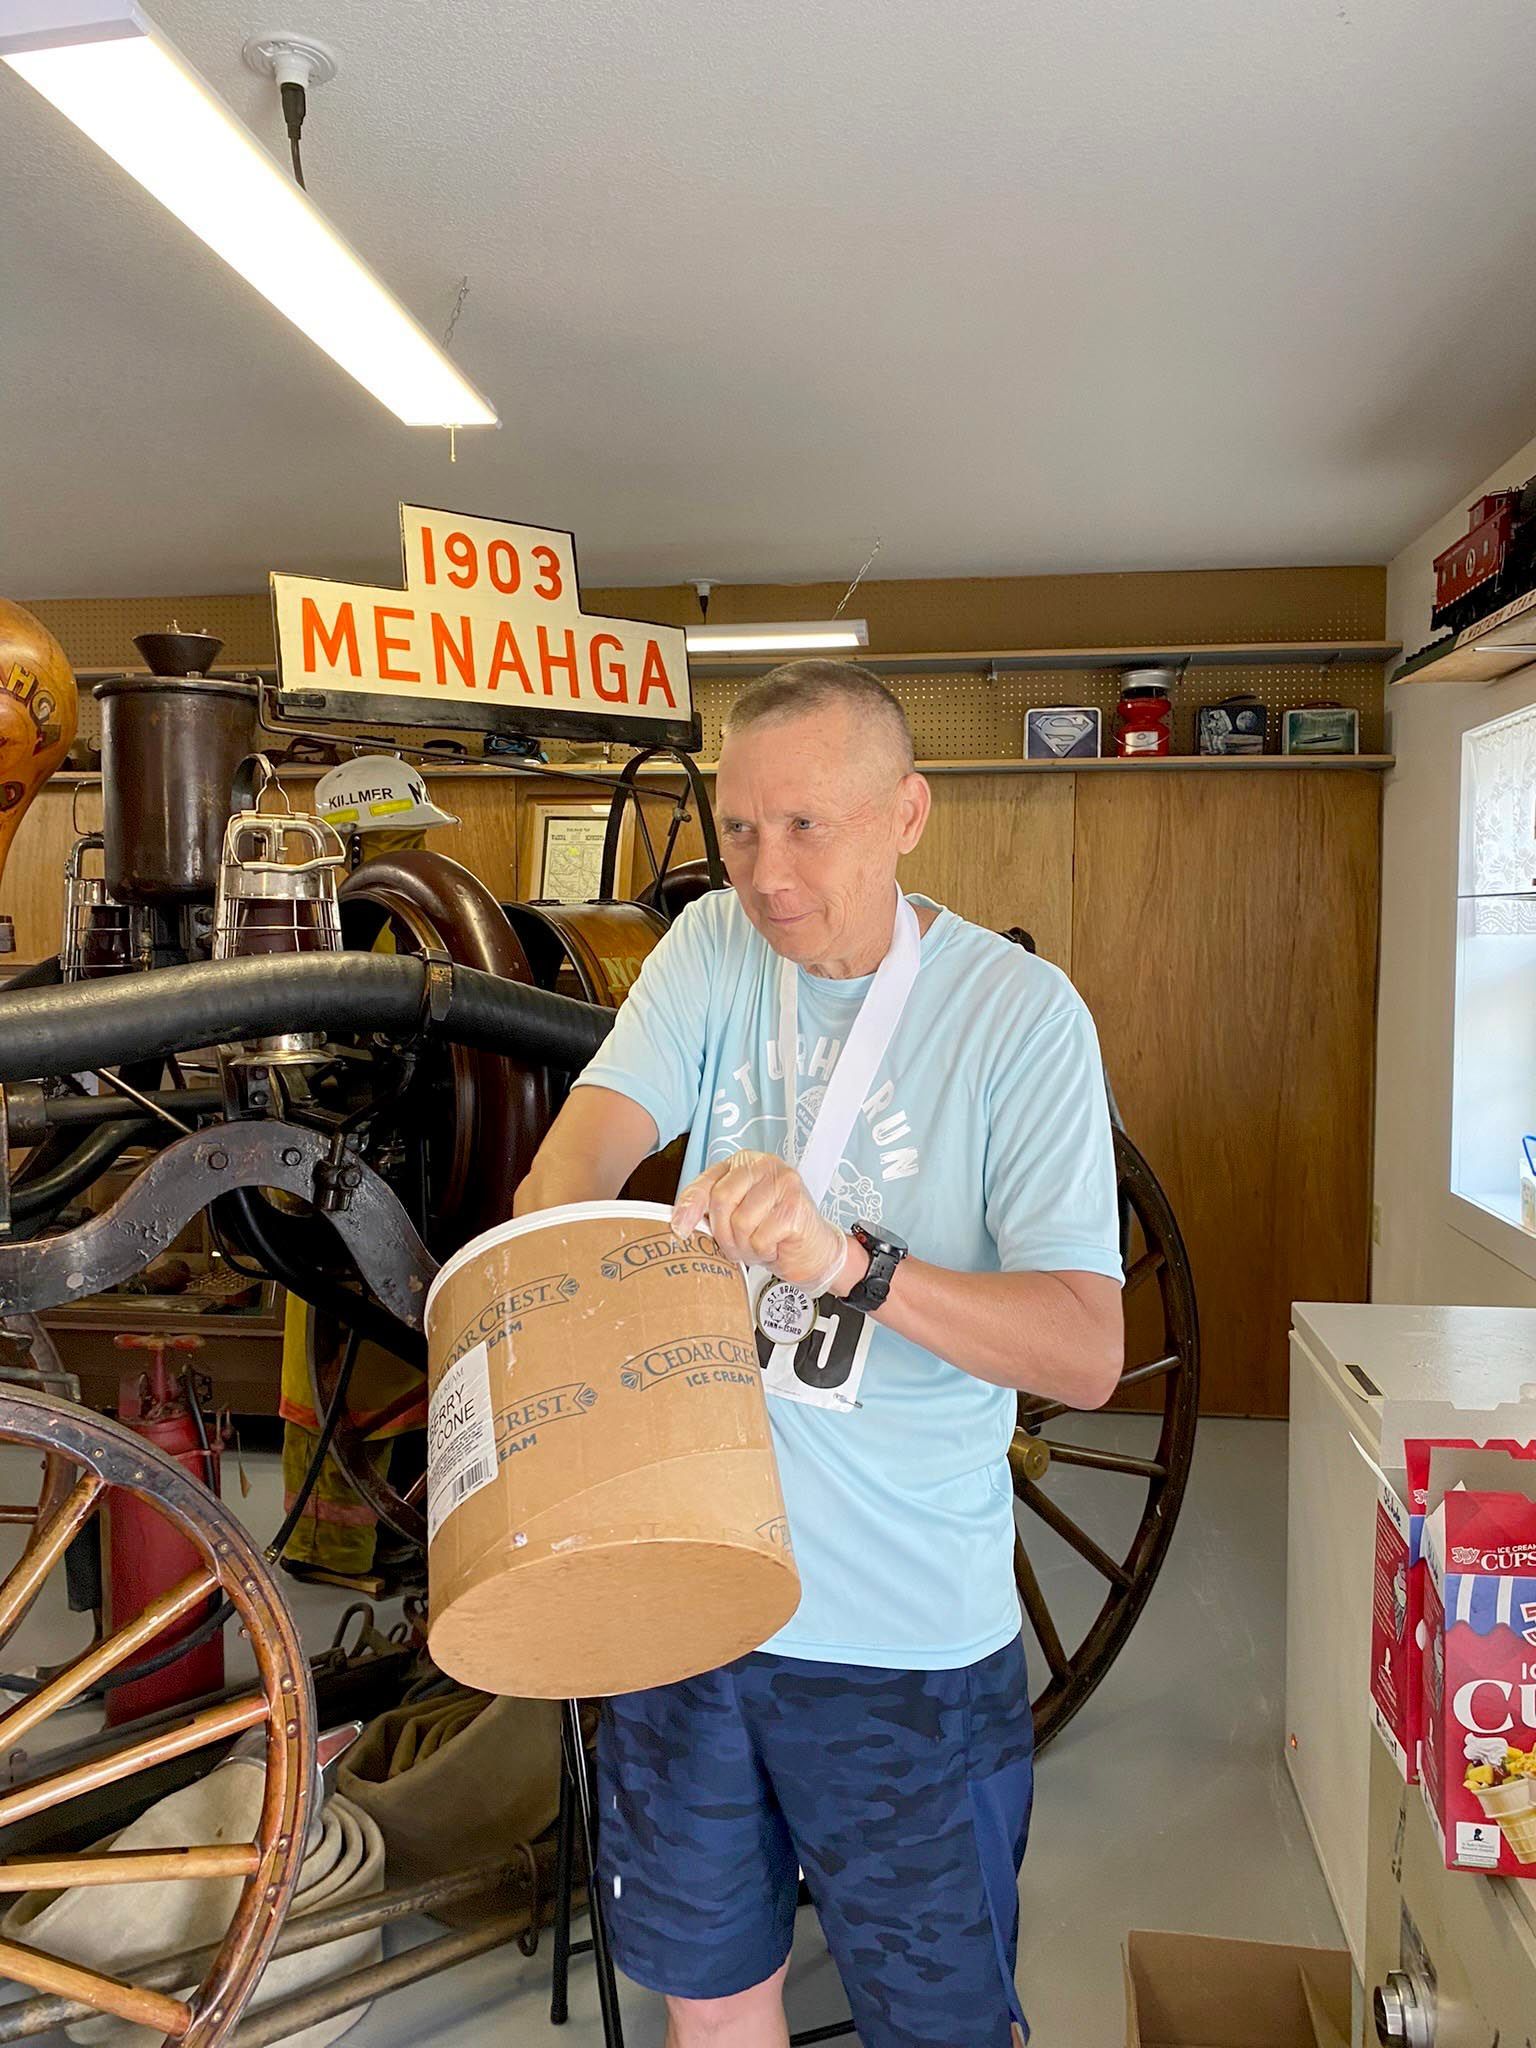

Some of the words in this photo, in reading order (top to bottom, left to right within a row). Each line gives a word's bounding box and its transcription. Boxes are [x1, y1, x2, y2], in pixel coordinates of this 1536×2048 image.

[421, 527, 563, 600] 1903
[301, 597, 677, 709] MENAHGA
[328, 786, 394, 810] KILLMER
[862, 1080, 919, 1182] RUN
[623, 1238, 698, 1267] CEDAR
[664, 1263, 688, 1277] ICE
[692, 1262, 733, 1279] CREAM
[479, 1283, 551, 1333] CREST
[643, 1342, 719, 1376] CEDAR
[686, 1373, 710, 1388] ICE
[712, 1371, 755, 1387] CREAM
[437, 1398, 476, 1450] CONE
[1481, 1551, 1536, 1571] CUPS
[1497, 1546, 1510, 1554] ICE
